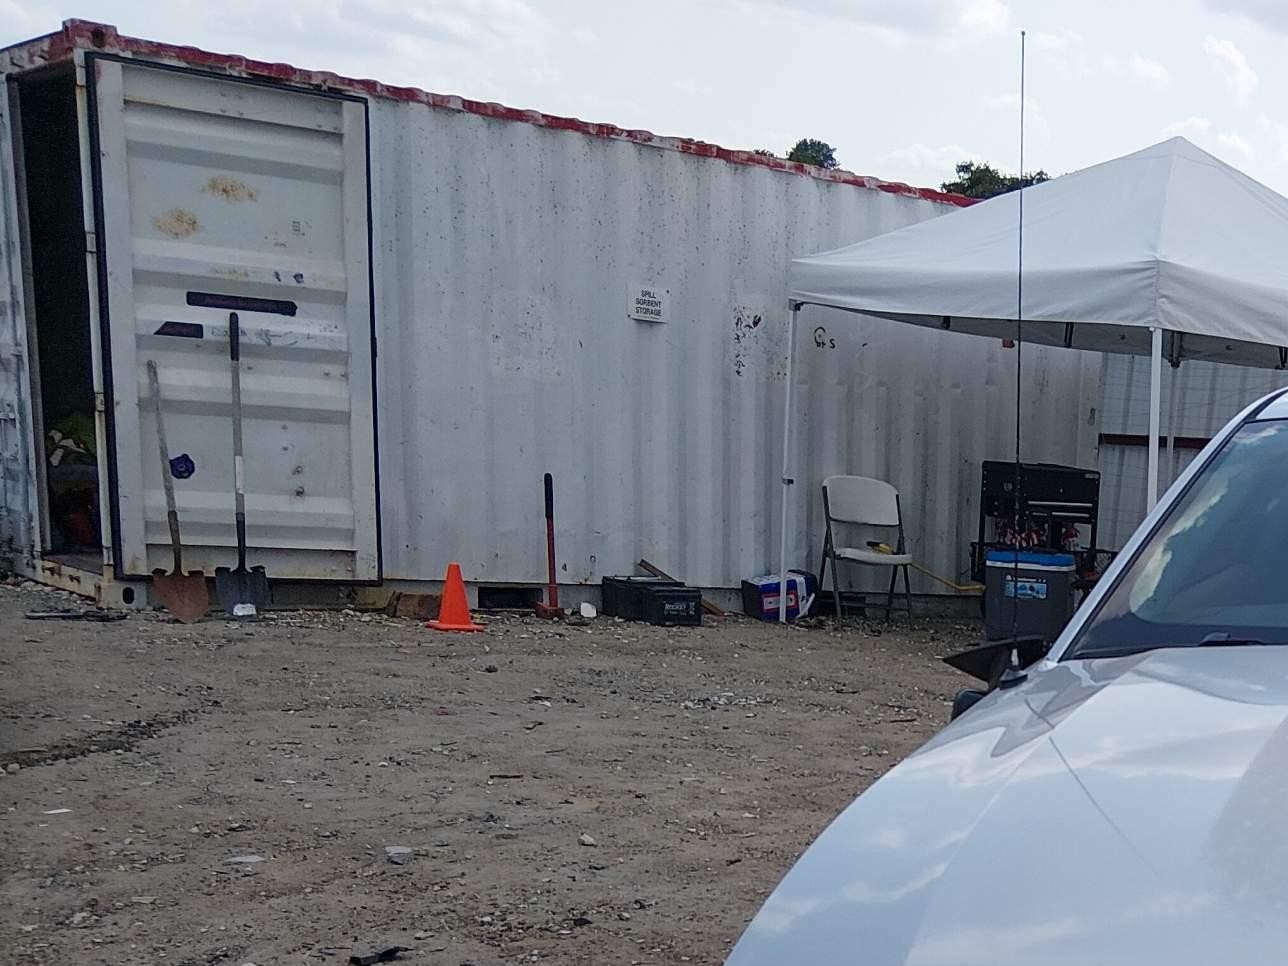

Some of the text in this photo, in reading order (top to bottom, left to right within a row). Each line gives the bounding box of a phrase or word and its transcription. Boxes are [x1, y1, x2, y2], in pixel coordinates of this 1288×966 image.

[641, 289, 656, 299] SPILL
[635, 297, 662, 308] SORBENT
[635, 306, 662, 317] STORAGE
